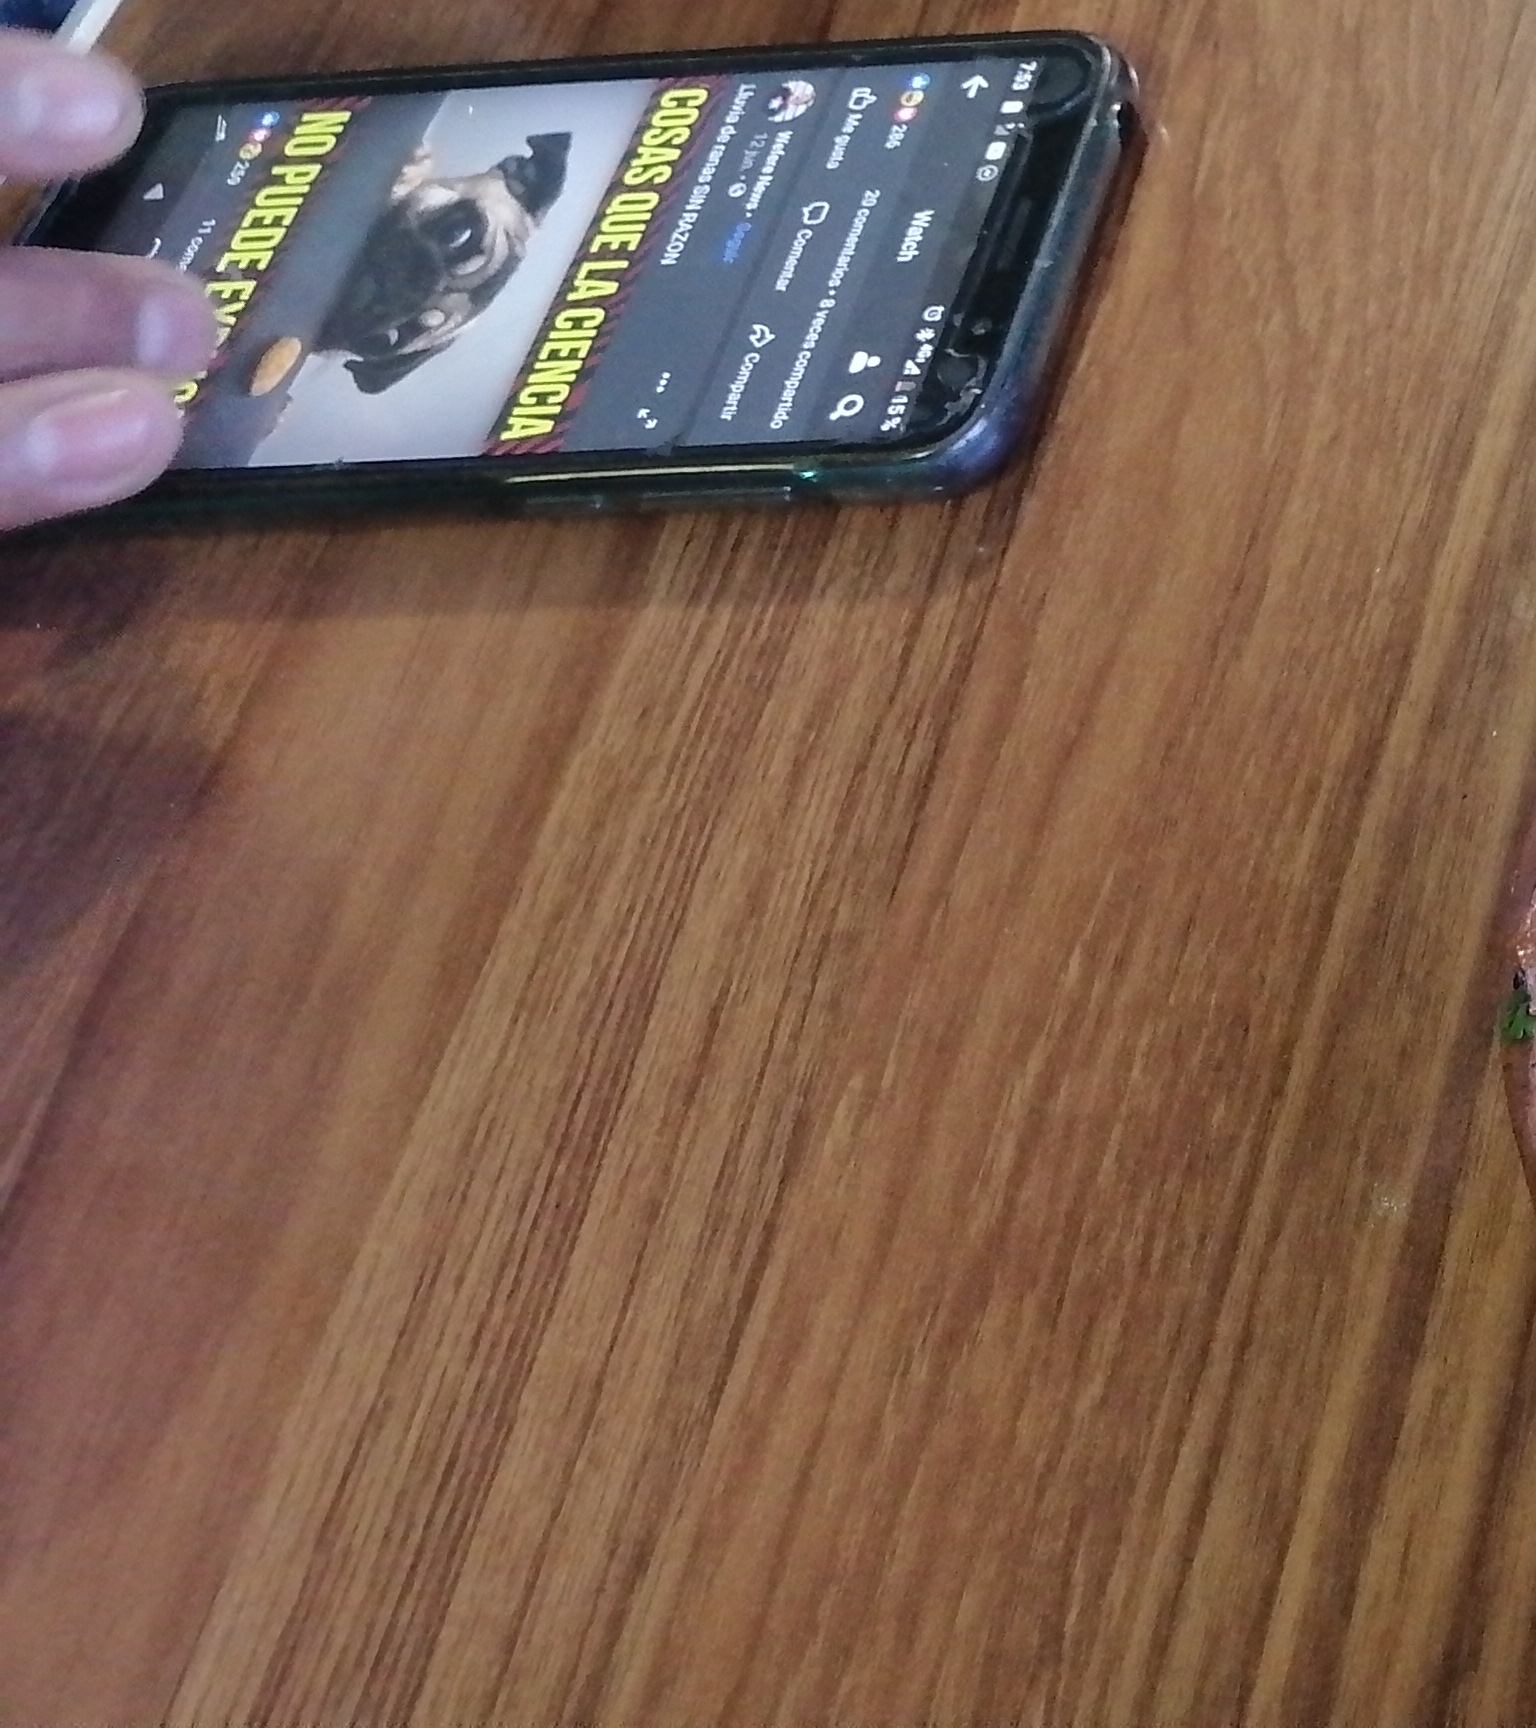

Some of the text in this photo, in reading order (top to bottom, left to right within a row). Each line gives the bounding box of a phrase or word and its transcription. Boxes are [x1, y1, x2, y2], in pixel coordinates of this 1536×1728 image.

[1013, 61, 1037, 91] 7:53
[215, 111, 352, 272] NO PUEDE
[686, 184, 711, 210] SIN
[862, 189, 881, 207] 20
[501, 86, 709, 441] COSAS QUE LA CIENCIA
[660, 212, 698, 265] RAZON
[775, 229, 812, 292] Comentar
[828, 208, 870, 287] comentarios
[897, 209, 935, 262] Watch
[805, 311, 829, 348] veces
[720, 352, 760, 421] Compartir
[770, 350, 811, 429] compartido
